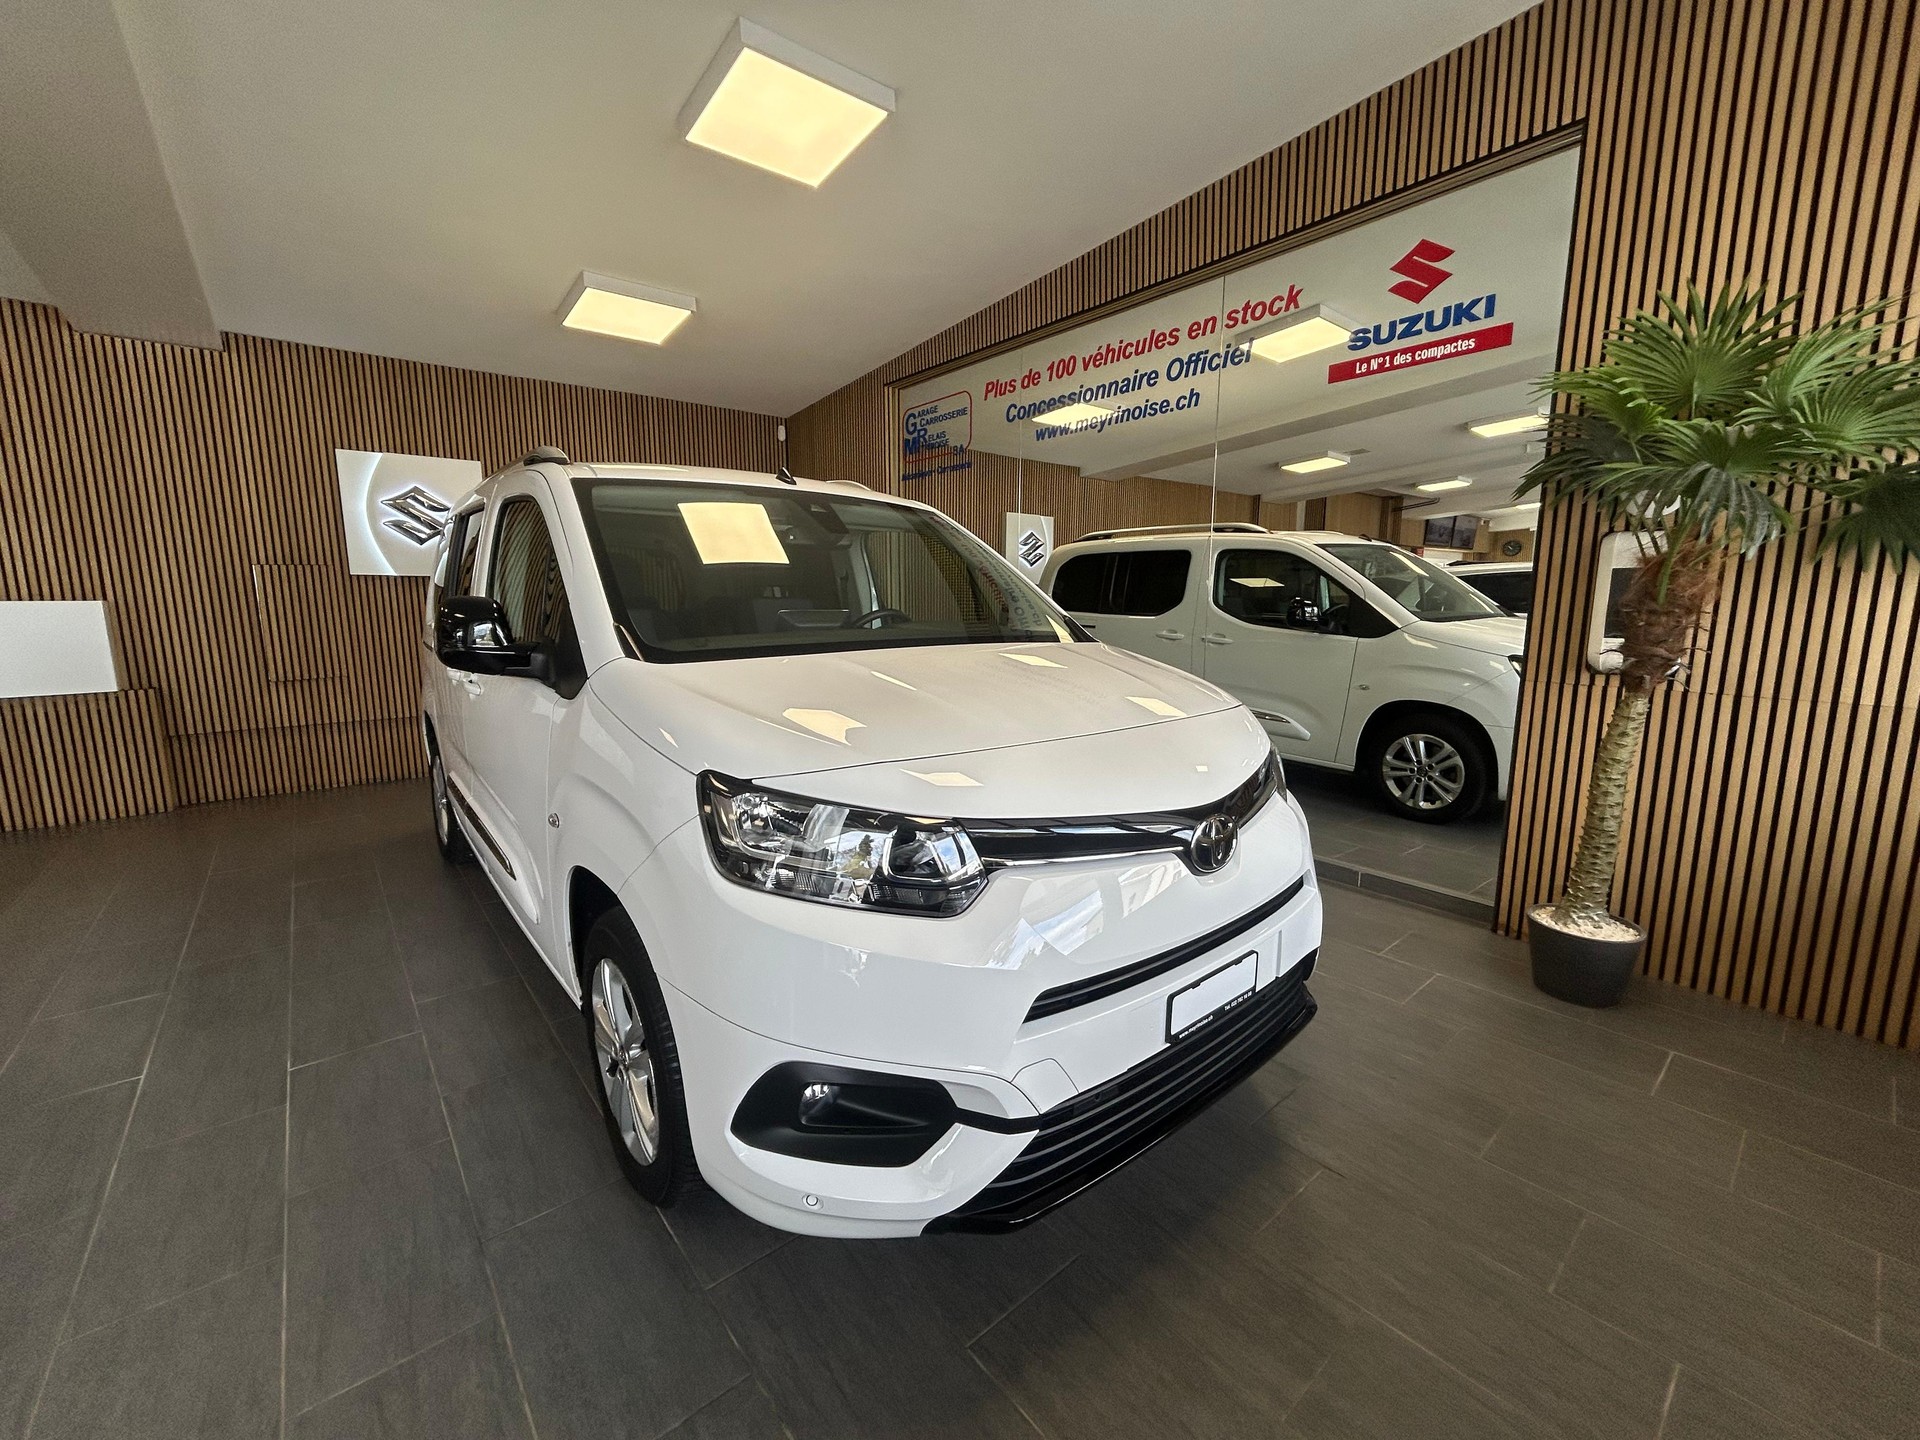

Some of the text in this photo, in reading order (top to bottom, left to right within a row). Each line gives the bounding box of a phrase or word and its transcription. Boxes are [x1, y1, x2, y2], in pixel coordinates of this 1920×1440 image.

[983, 283, 1304, 401] Plus de 100 véhicules en stock
[1347, 293, 1497, 351] SUZUKI
[1005, 336, 1255, 423] Concessionnaire Officiel
[1355, 361, 1368, 375] Le
[1393, 352, 1412, 366] des
[1414, 337, 1476, 359] compactes
[919, 406, 968, 428] CARROSSERIE
[1035, 387, 1201, 442] www.meyrinoise.ch
